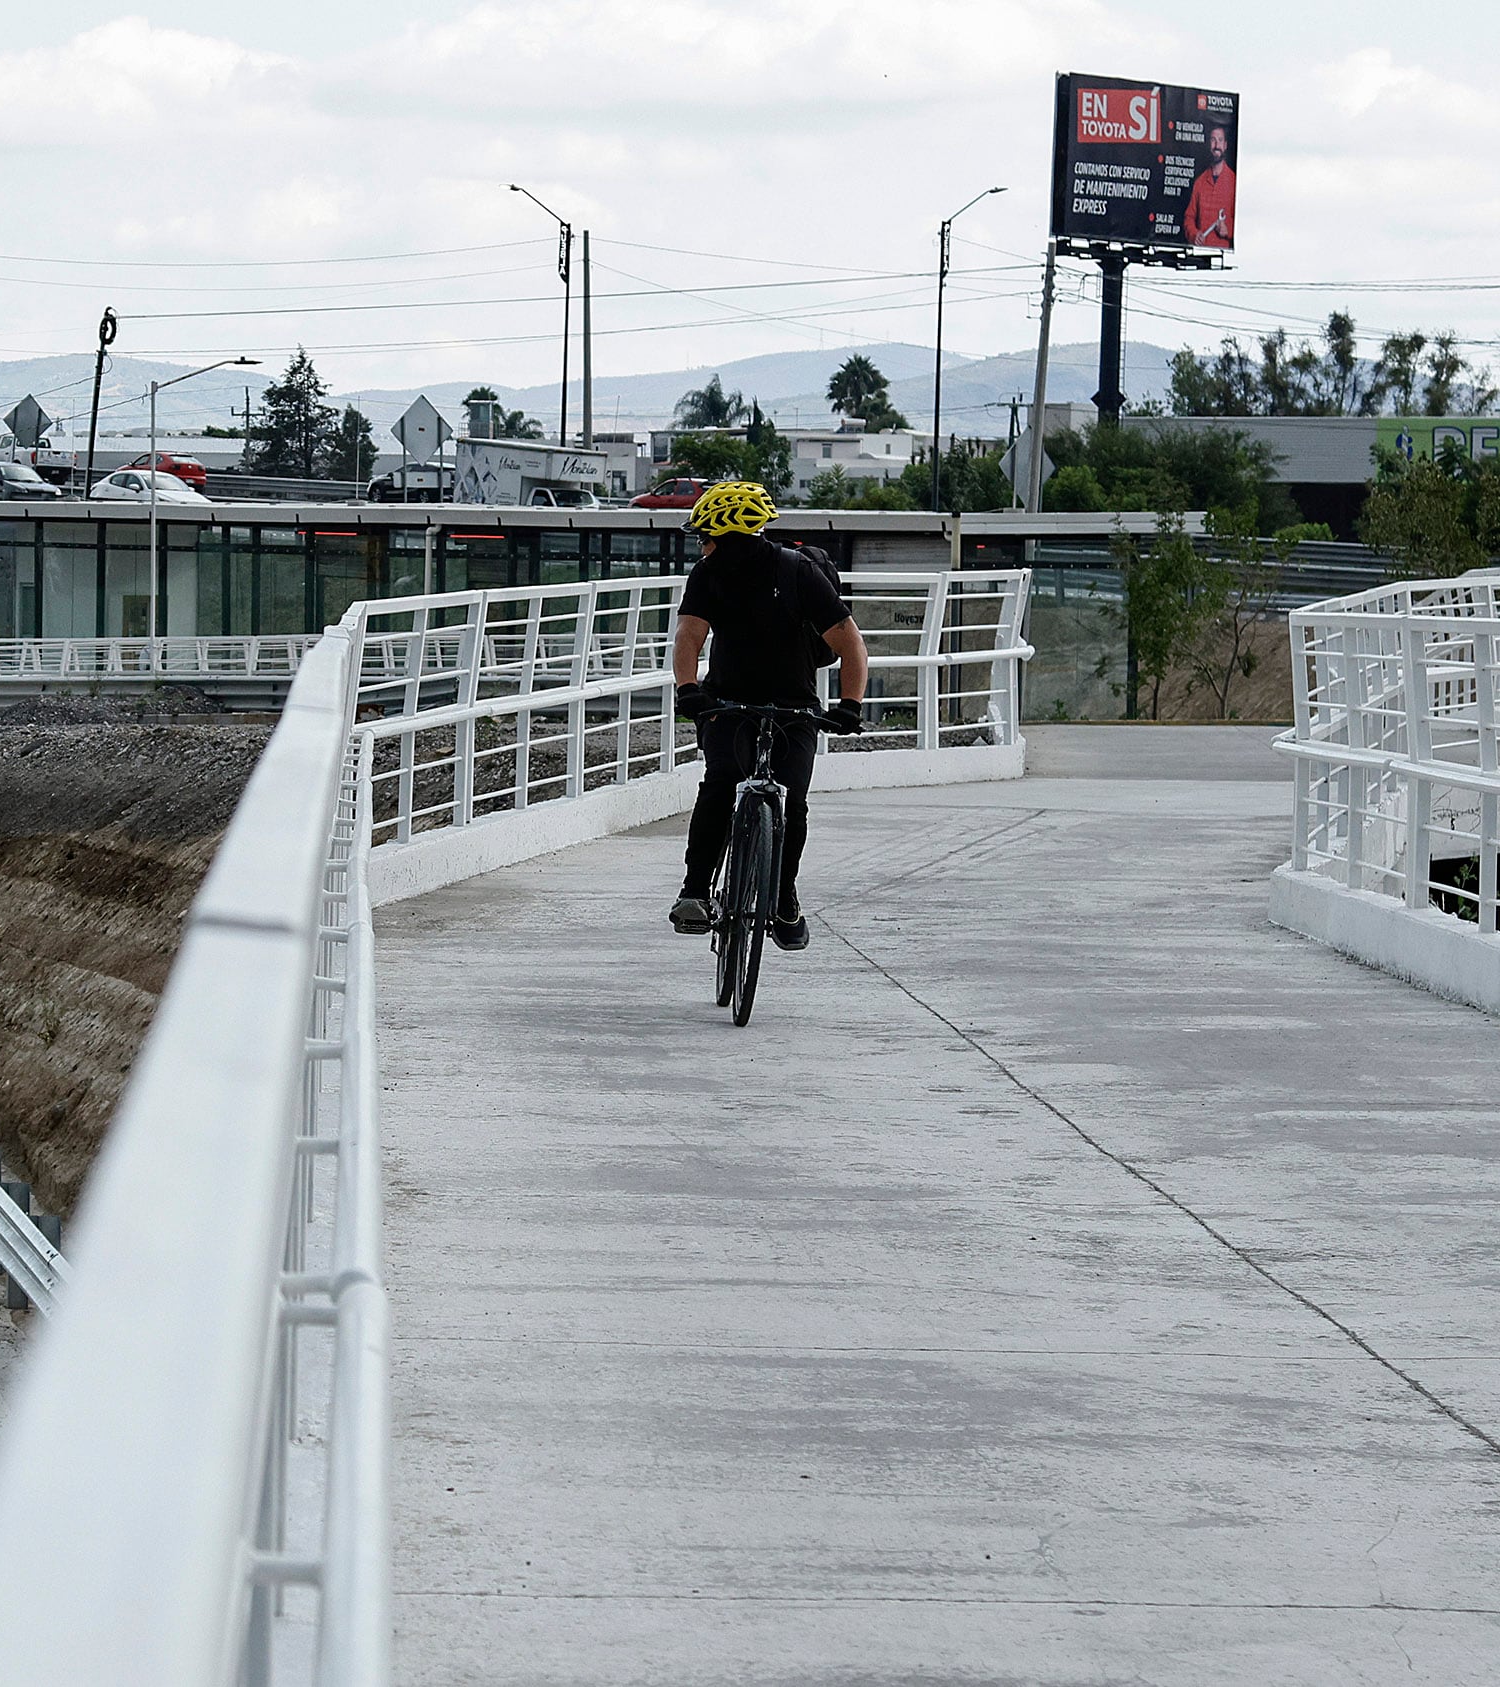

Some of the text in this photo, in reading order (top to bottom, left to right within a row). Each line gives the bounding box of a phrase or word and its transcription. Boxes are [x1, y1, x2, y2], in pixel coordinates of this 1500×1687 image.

[1082, 91, 1107, 119] EN
[1207, 95, 1233, 107] TOYOTA
[1128, 86, 1160, 141] SÍ
[1081, 119, 1127, 139] TOYOTA
[1074, 161, 1151, 181] CONTAMOS CON SERVICIO
[1073, 178, 1148, 200] DE MANTENIMIENTO
[1072, 198, 1108, 216] EXPRESS
